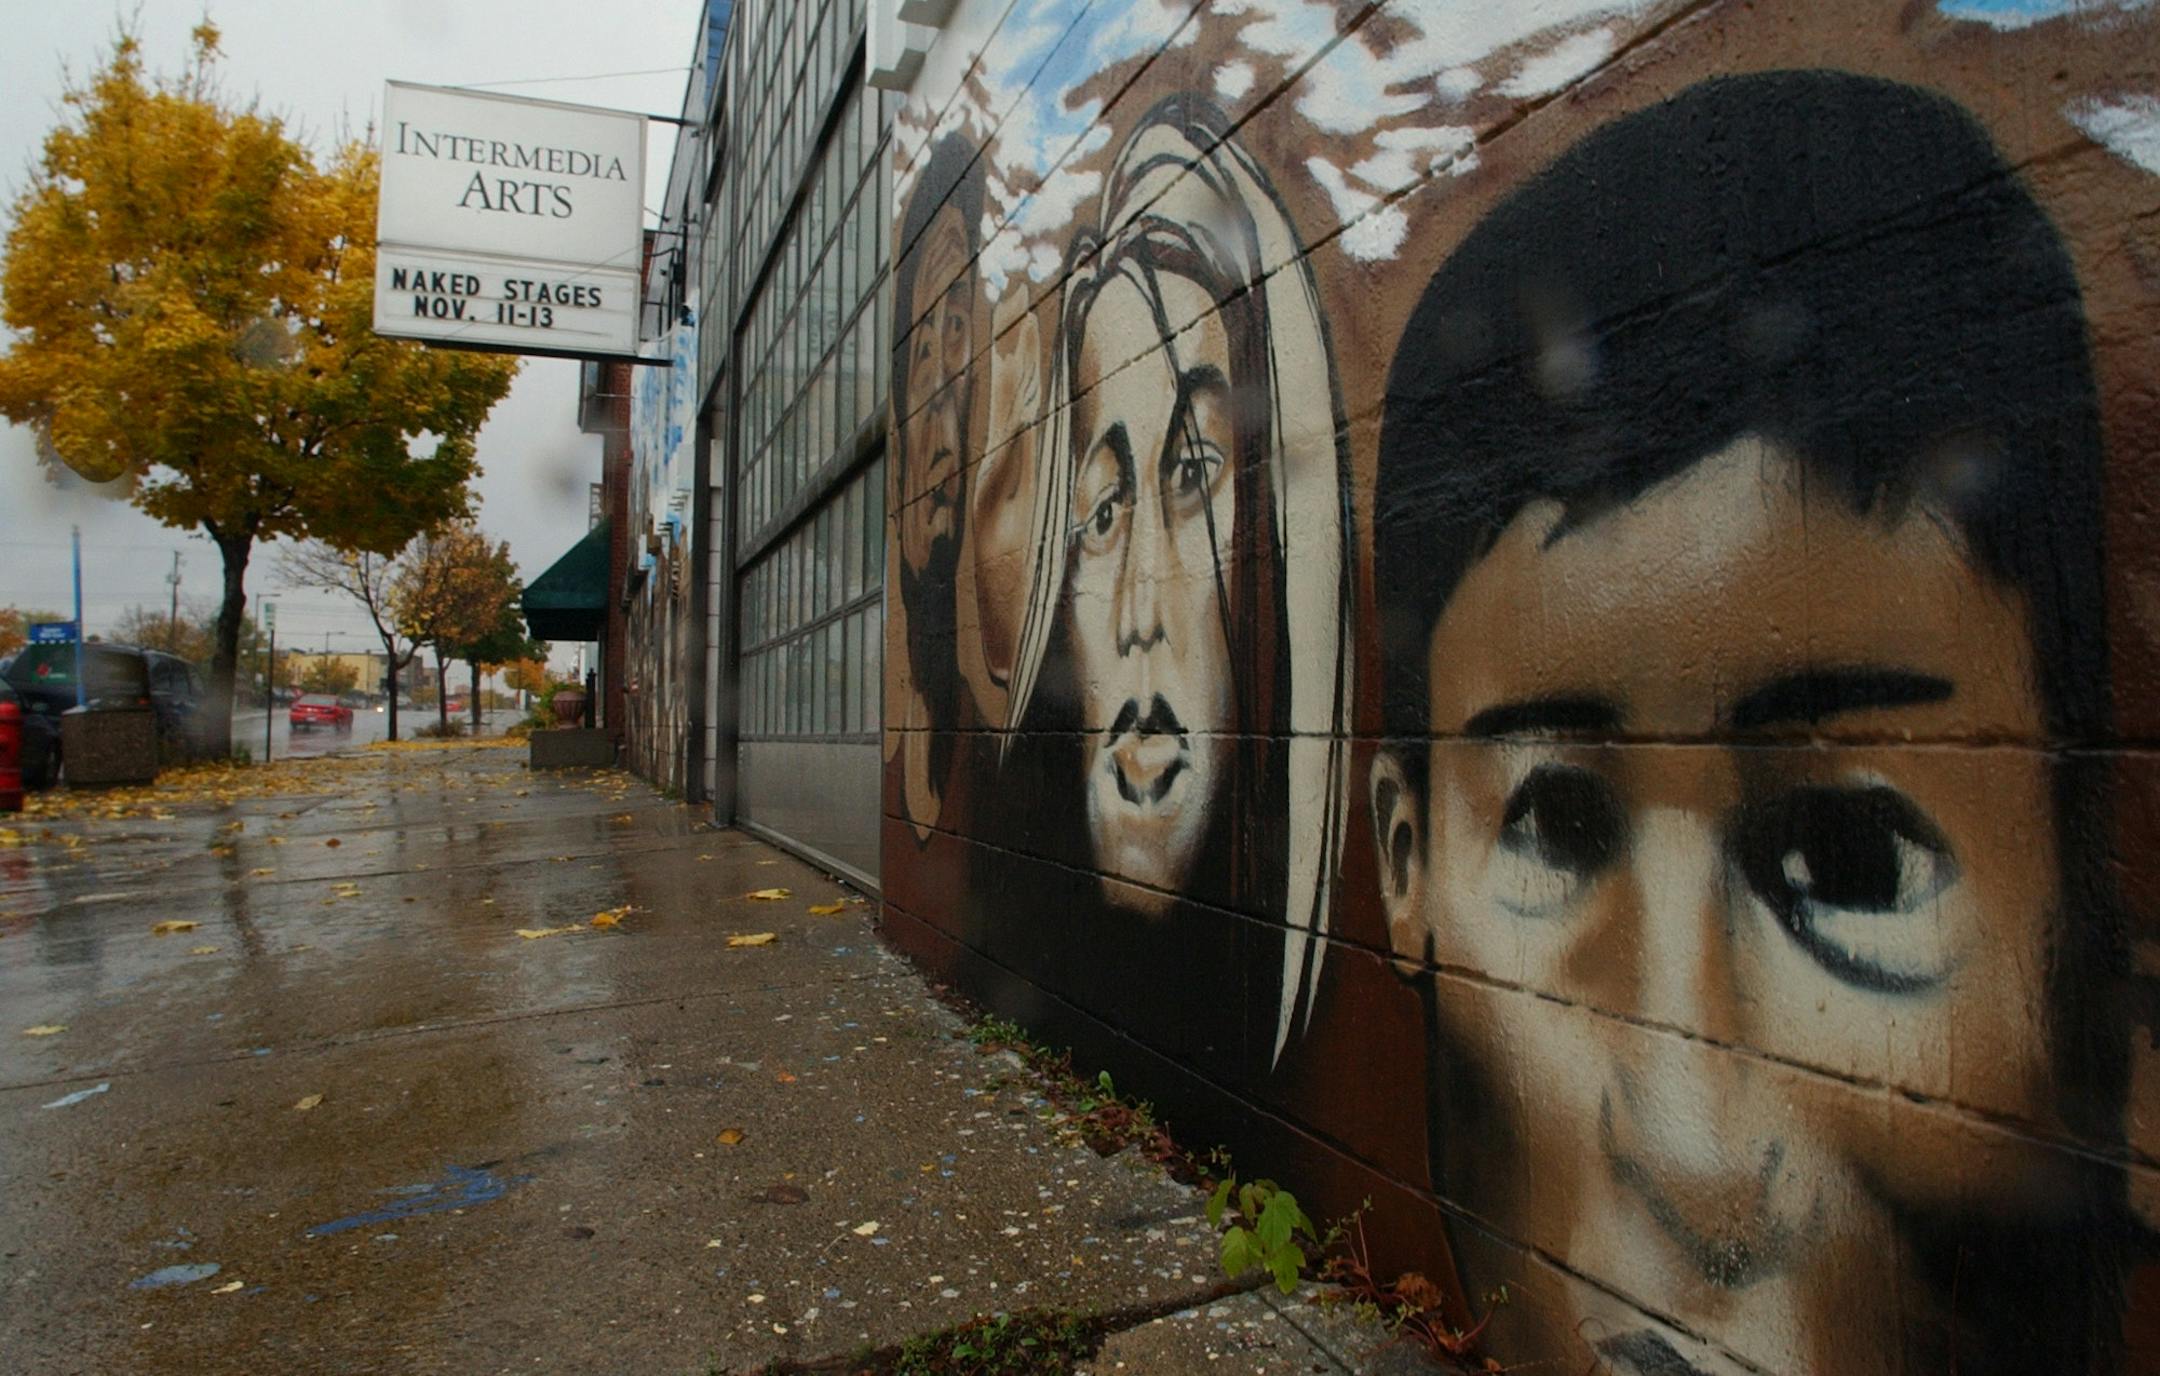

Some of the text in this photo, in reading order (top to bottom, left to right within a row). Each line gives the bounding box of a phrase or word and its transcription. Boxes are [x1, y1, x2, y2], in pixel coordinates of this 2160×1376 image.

[396, 121, 627, 181] INTERMEDIA
[456, 170, 573, 219] ARTS
[392, 268, 602, 308] NAKED STAGES
[414, 295, 553, 328] NOV. 11-13
